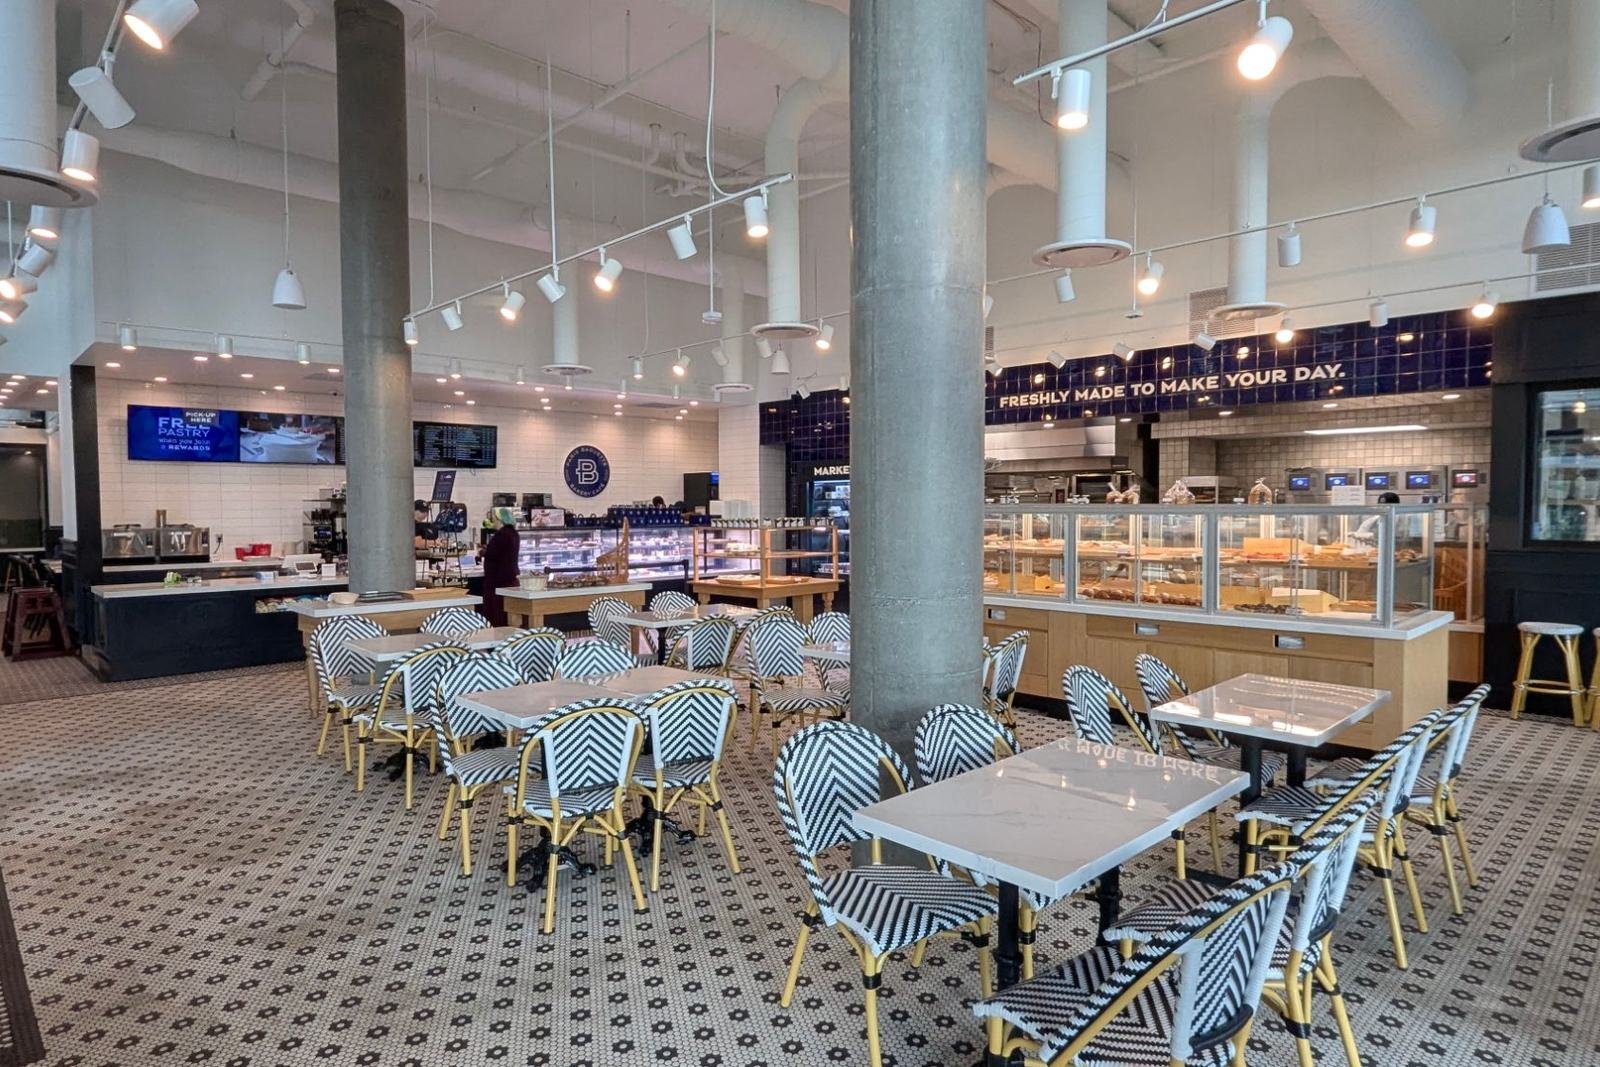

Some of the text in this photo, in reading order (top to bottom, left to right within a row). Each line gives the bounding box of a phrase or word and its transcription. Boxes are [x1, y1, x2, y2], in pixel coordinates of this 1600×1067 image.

[999, 363, 1346, 408] FRESHLY MADE TO MAKE YOUR DAY.
[158, 428, 210, 438] PASTRY
